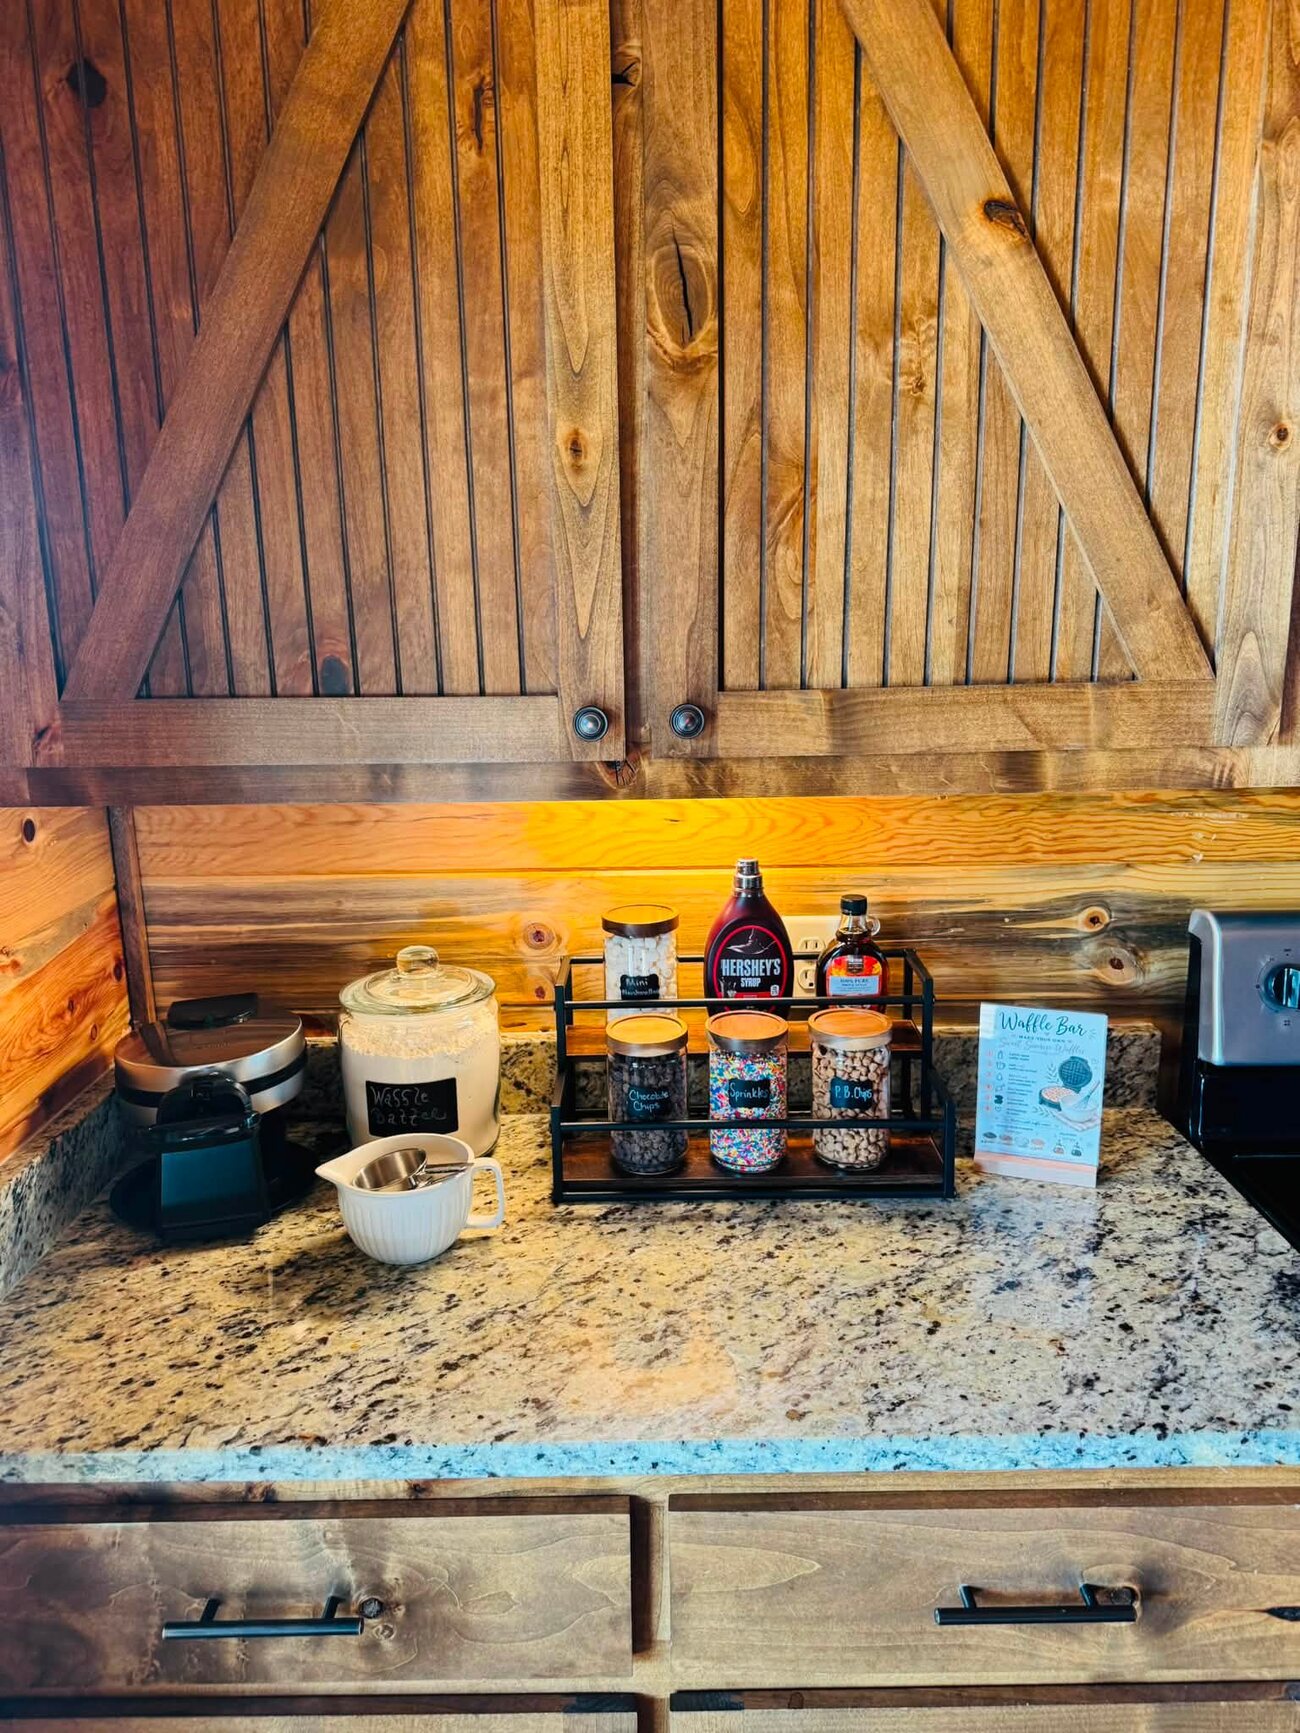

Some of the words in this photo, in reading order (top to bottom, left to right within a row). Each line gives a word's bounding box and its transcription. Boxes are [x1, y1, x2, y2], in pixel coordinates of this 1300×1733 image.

[721, 958, 780, 976] HERSHEY'S
[740, 977, 761, 988] SYRUP
[999, 1012, 1052, 1033] Waffle
[1056, 1016, 1088, 1036] Bar
[730, 1082, 769, 1102] Sprinkles
[633, 1100, 660, 1113] Chips
